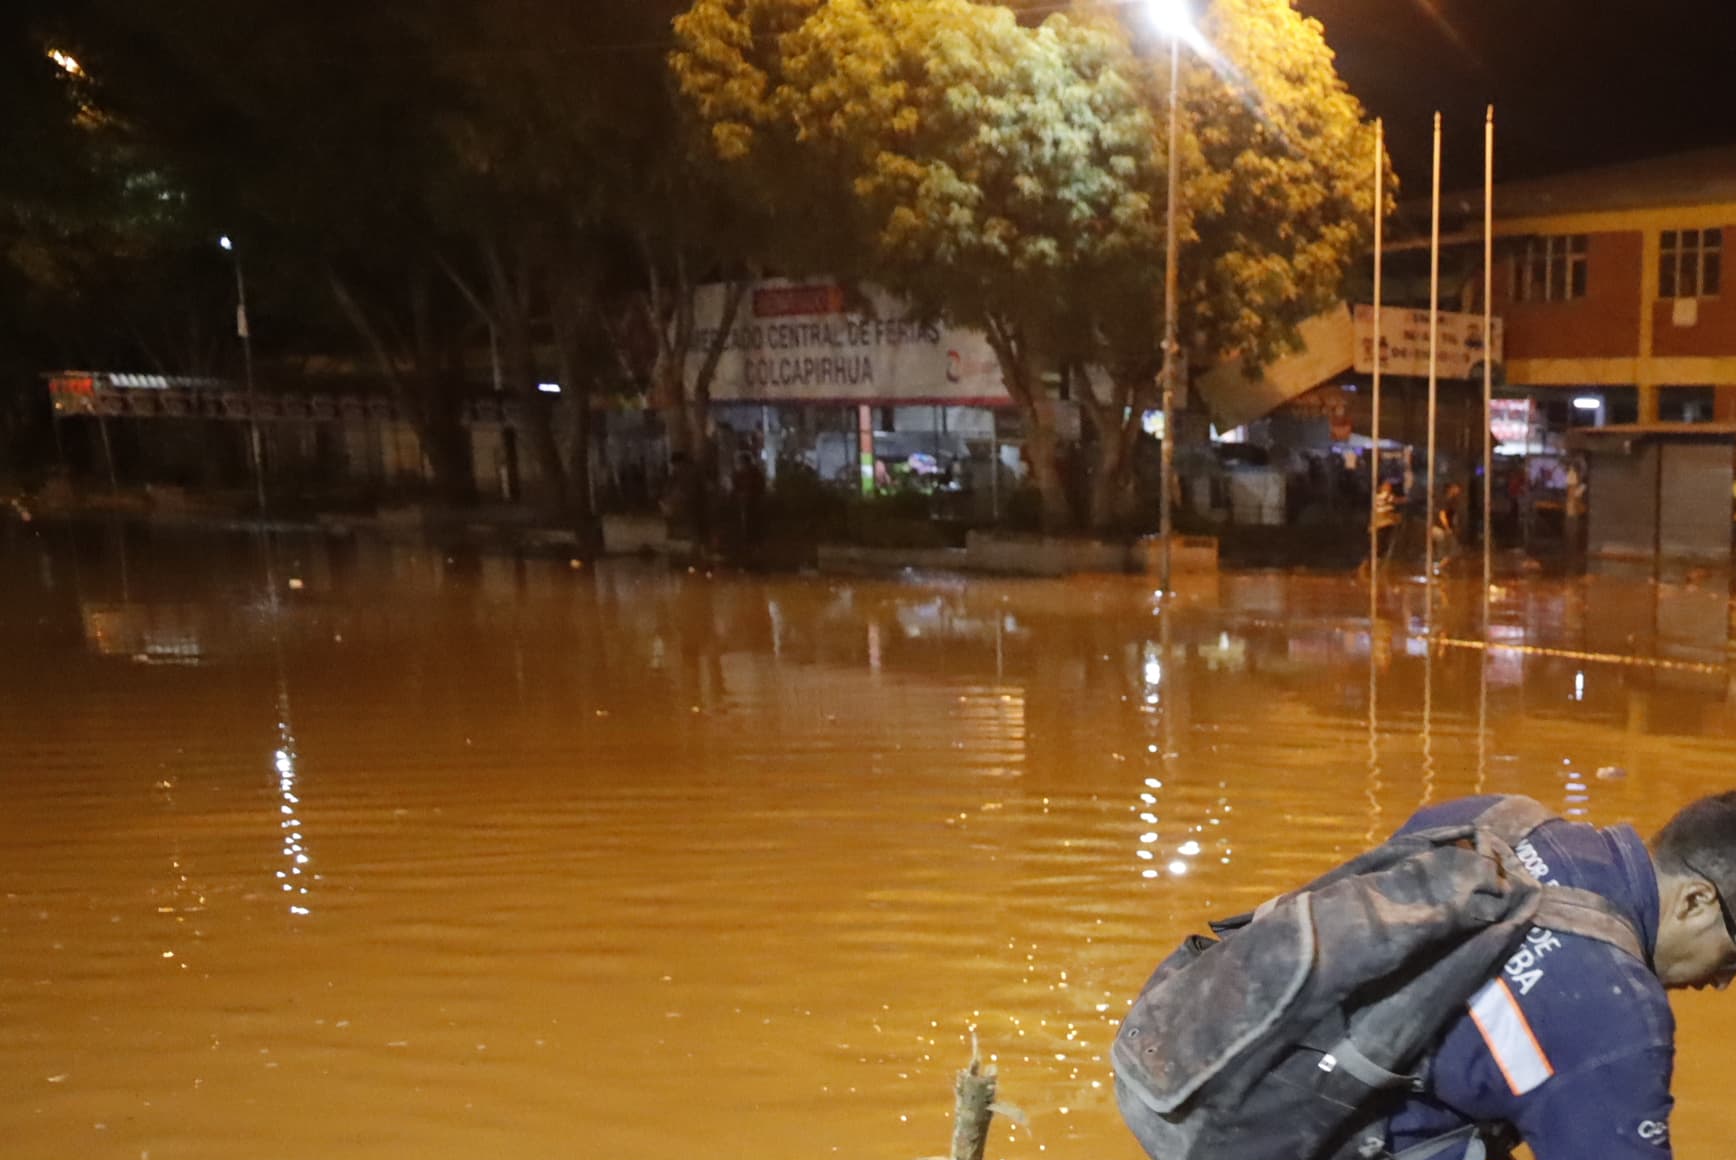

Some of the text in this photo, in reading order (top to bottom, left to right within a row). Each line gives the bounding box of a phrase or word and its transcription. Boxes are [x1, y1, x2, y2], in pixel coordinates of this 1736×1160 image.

[768, 323, 840, 350] CENTRAL
[847, 320, 869, 346] DE
[875, 319, 940, 345] FERIAS
[745, 356, 873, 387] COLCAPIRHUA
